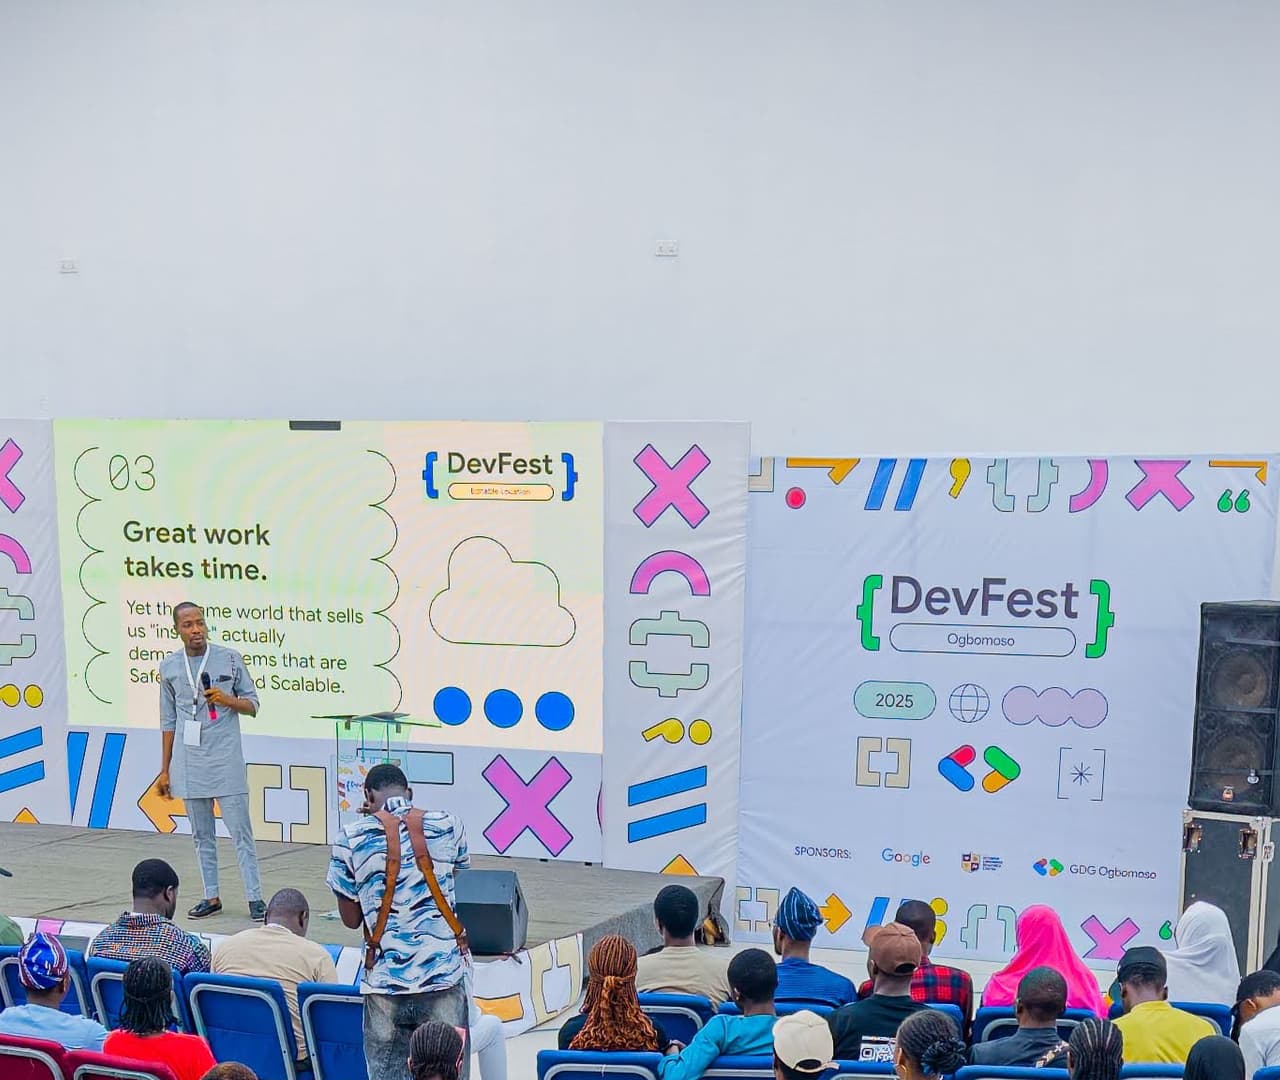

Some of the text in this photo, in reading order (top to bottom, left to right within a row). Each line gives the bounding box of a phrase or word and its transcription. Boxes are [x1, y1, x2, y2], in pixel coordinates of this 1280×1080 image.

[108, 454, 156, 491] 03
[447, 452, 553, 475] DevFest
[123, 520, 270, 546] Great work
[124, 555, 268, 581] takes time.
[890, 575, 1079, 619] DevFest
[126, 599, 151, 616] Yet
[157, 601, 173, 616] th
[236, 604, 284, 621] world
[288, 606, 322, 622] that
[327, 607, 364, 624] sells
[127, 626, 146, 639] us
[222, 628, 286, 648] actually
[947, 632, 1015, 649] Ogbomoso
[283, 652, 315, 668] that
[320, 658, 348, 670] are
[270, 675, 345, 694] Scalable.
[875, 693, 914, 708] 2025
[794, 845, 852, 859] SPONSORS:
[881, 847, 931, 866] Google
[1069, 864, 1157, 880] GDG Ogbomoso
